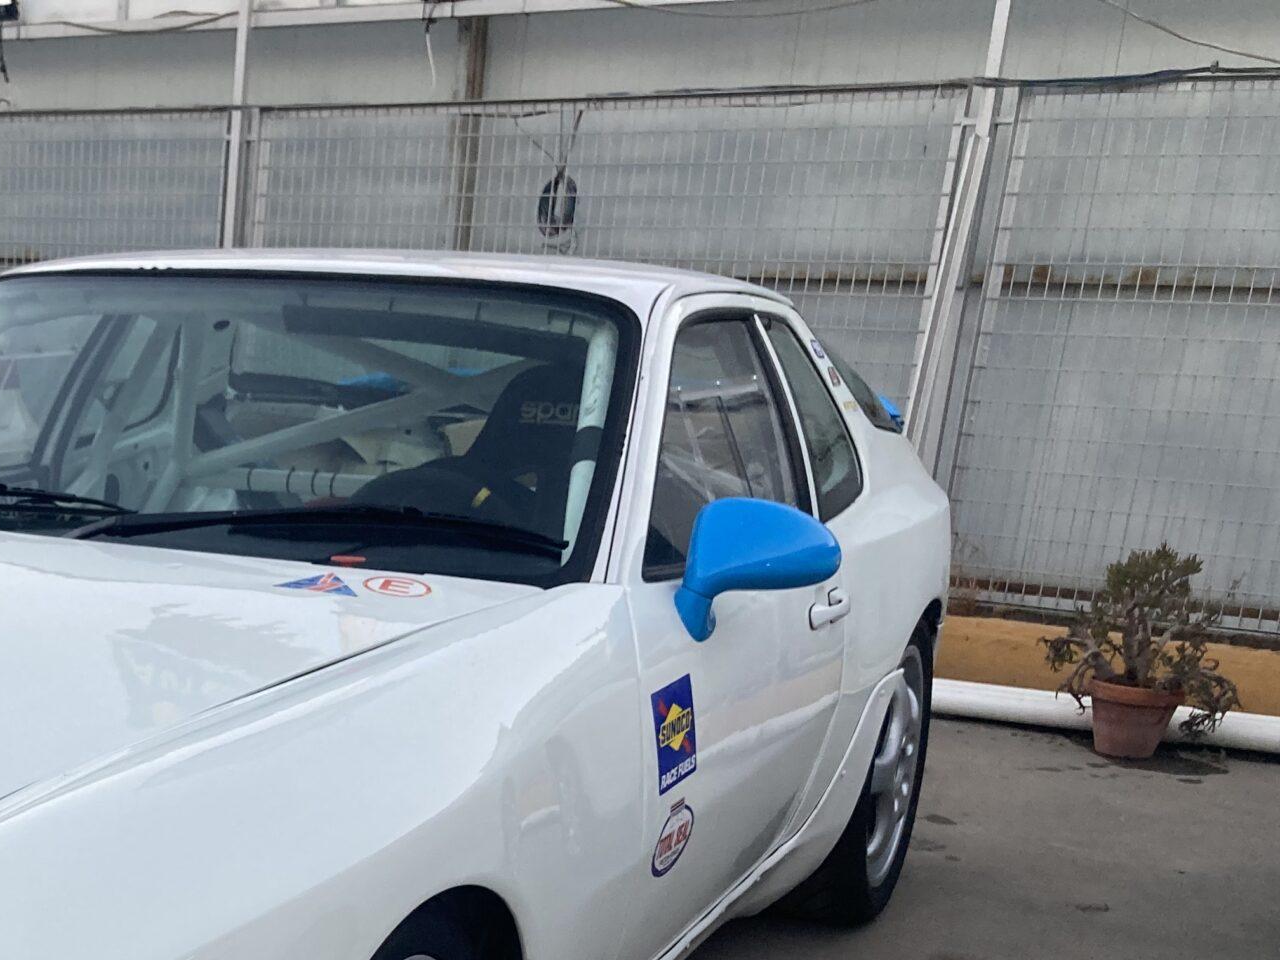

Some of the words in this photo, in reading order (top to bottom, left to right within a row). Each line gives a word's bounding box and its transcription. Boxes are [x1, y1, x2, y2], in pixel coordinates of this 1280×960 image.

[520, 402, 579, 425] spar
[660, 709, 691, 746] SUNOCO
[661, 766, 679, 790] RACE
[678, 753, 696, 778] FUELS
